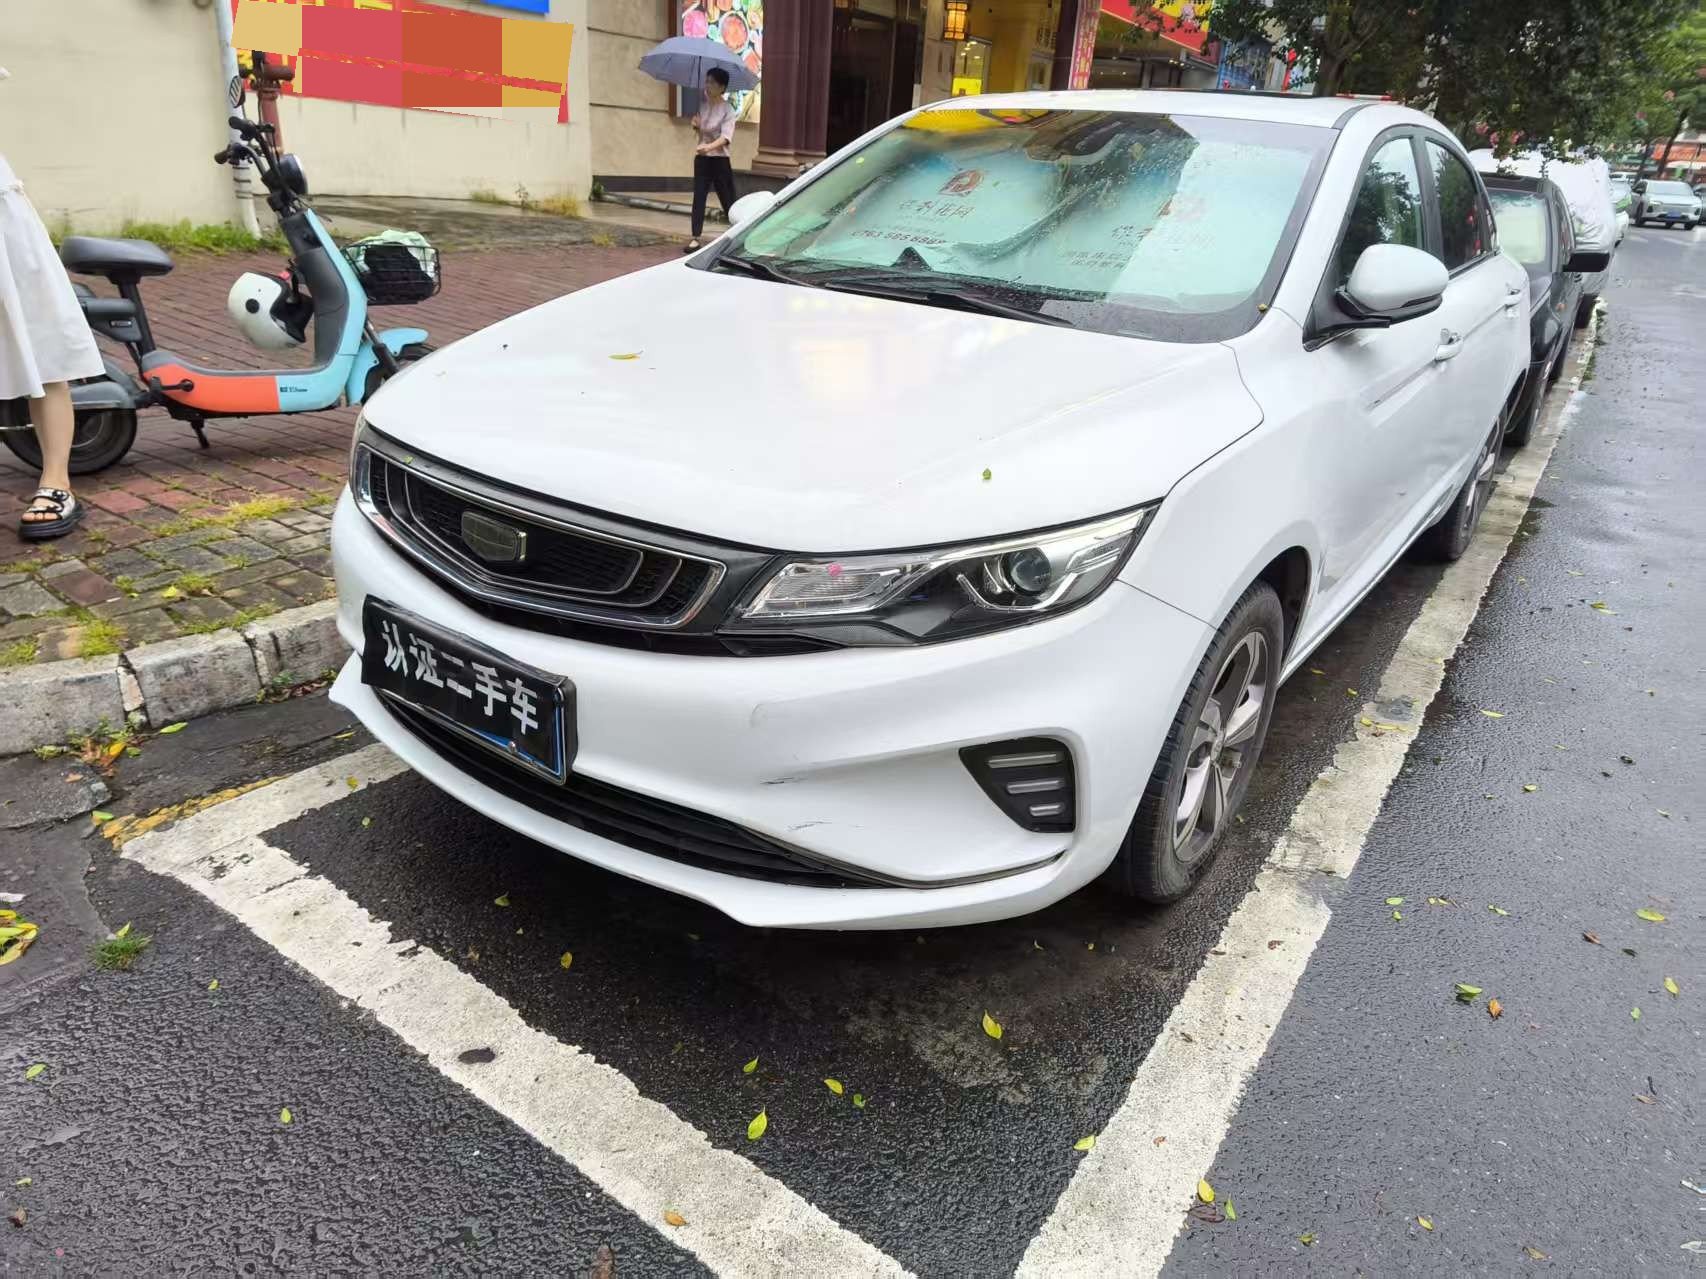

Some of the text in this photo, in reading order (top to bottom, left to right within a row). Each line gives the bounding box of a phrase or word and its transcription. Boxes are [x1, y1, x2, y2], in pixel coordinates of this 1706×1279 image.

[381, 620, 539, 735] 认证二手车
